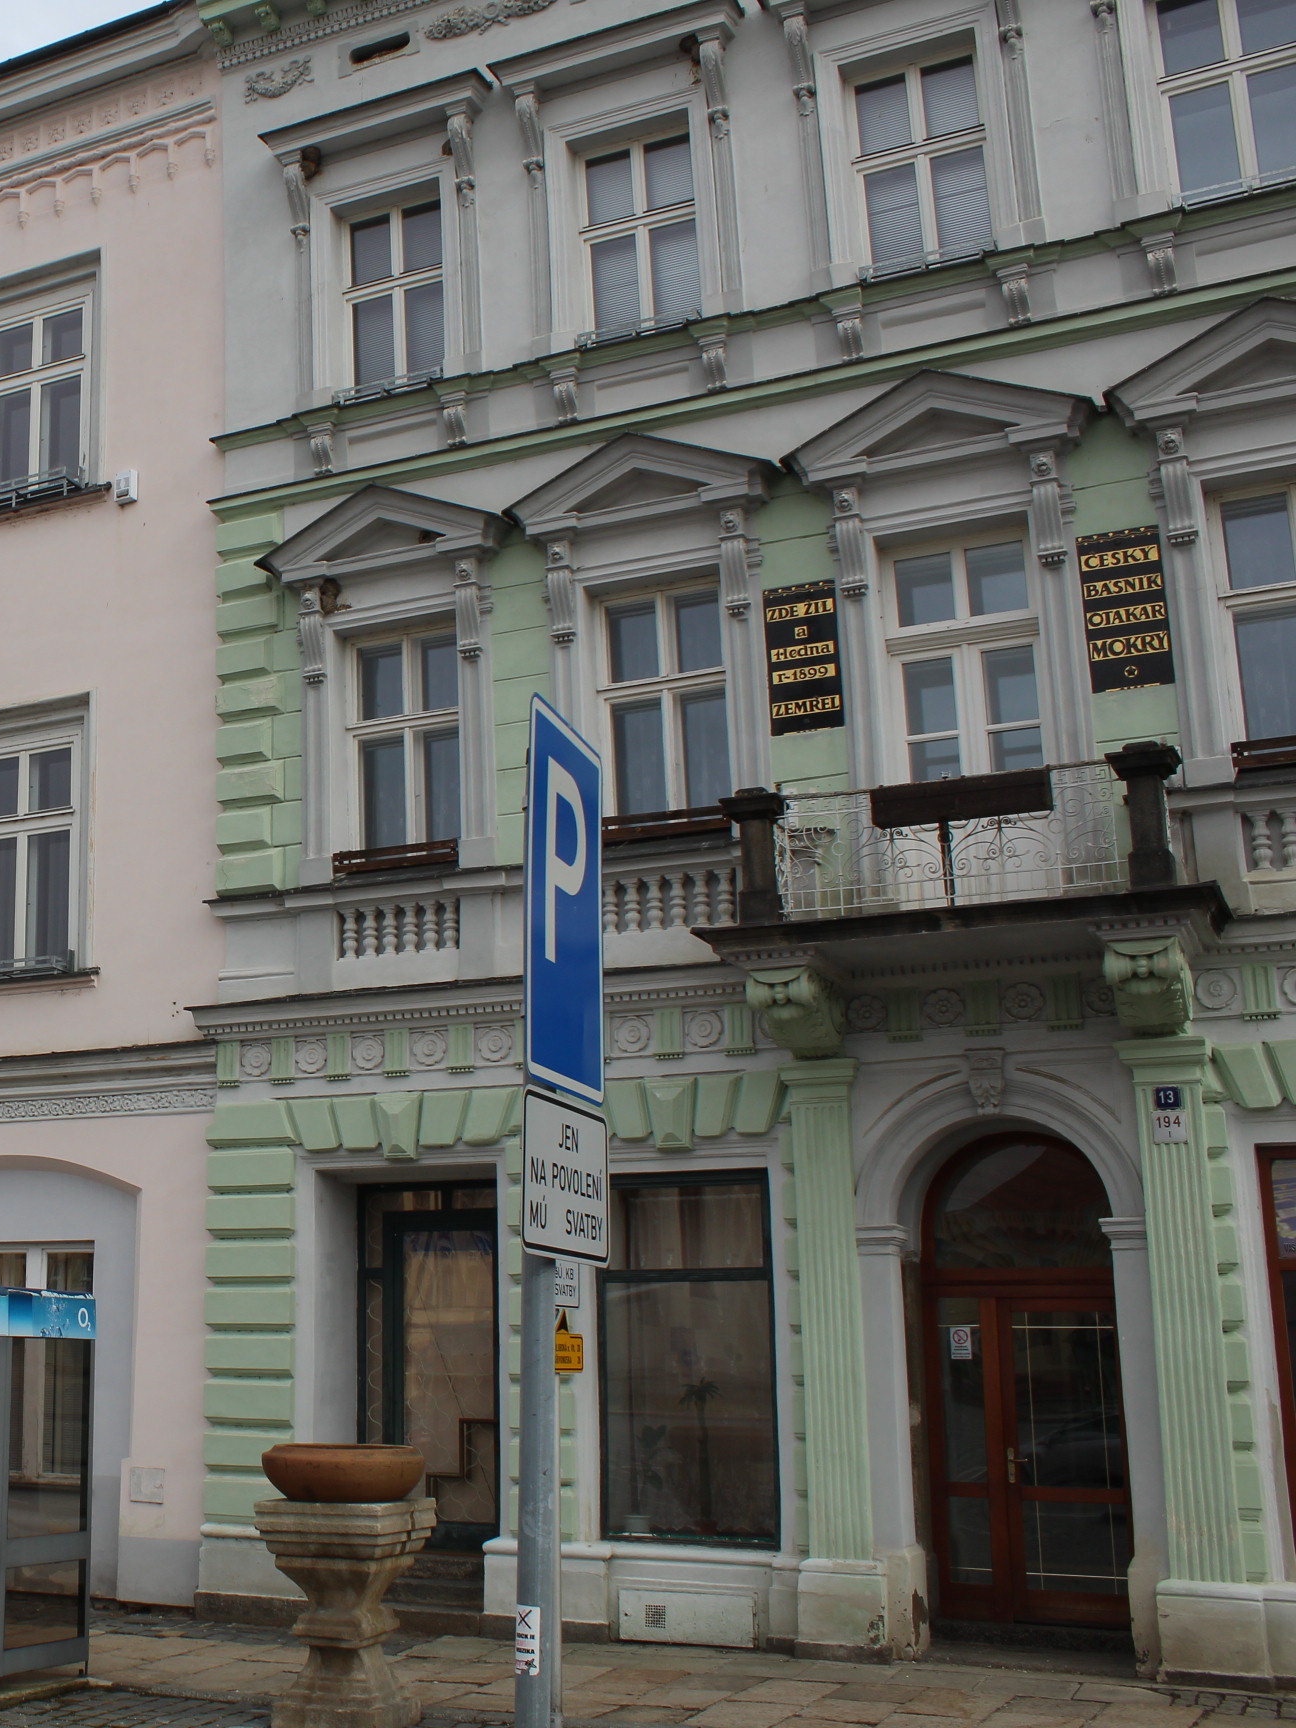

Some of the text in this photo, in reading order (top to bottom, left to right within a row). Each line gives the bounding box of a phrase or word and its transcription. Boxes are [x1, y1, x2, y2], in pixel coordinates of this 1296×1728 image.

[768, 599, 831, 621] ZDE ŽIL
[1088, 603, 1166, 627] OTAKAR
[796, 627, 807, 638] a
[1092, 631, 1168, 660] MOKRÝ
[774, 695, 839, 717] ZEMŘEL
[545, 755, 586, 963] P
[1158, 1091, 1174, 1103] 13
[1156, 1115, 1181, 1128] 194
[558, 1123, 578, 1153] JEN
[531, 1156, 602, 1202] NA POVOLENÍ
[530, 1195, 603, 1241] MÚ SVATBY
[555, 1283, 576, 1297] SVATBY
[77, 1307, 92, 1332] O2
